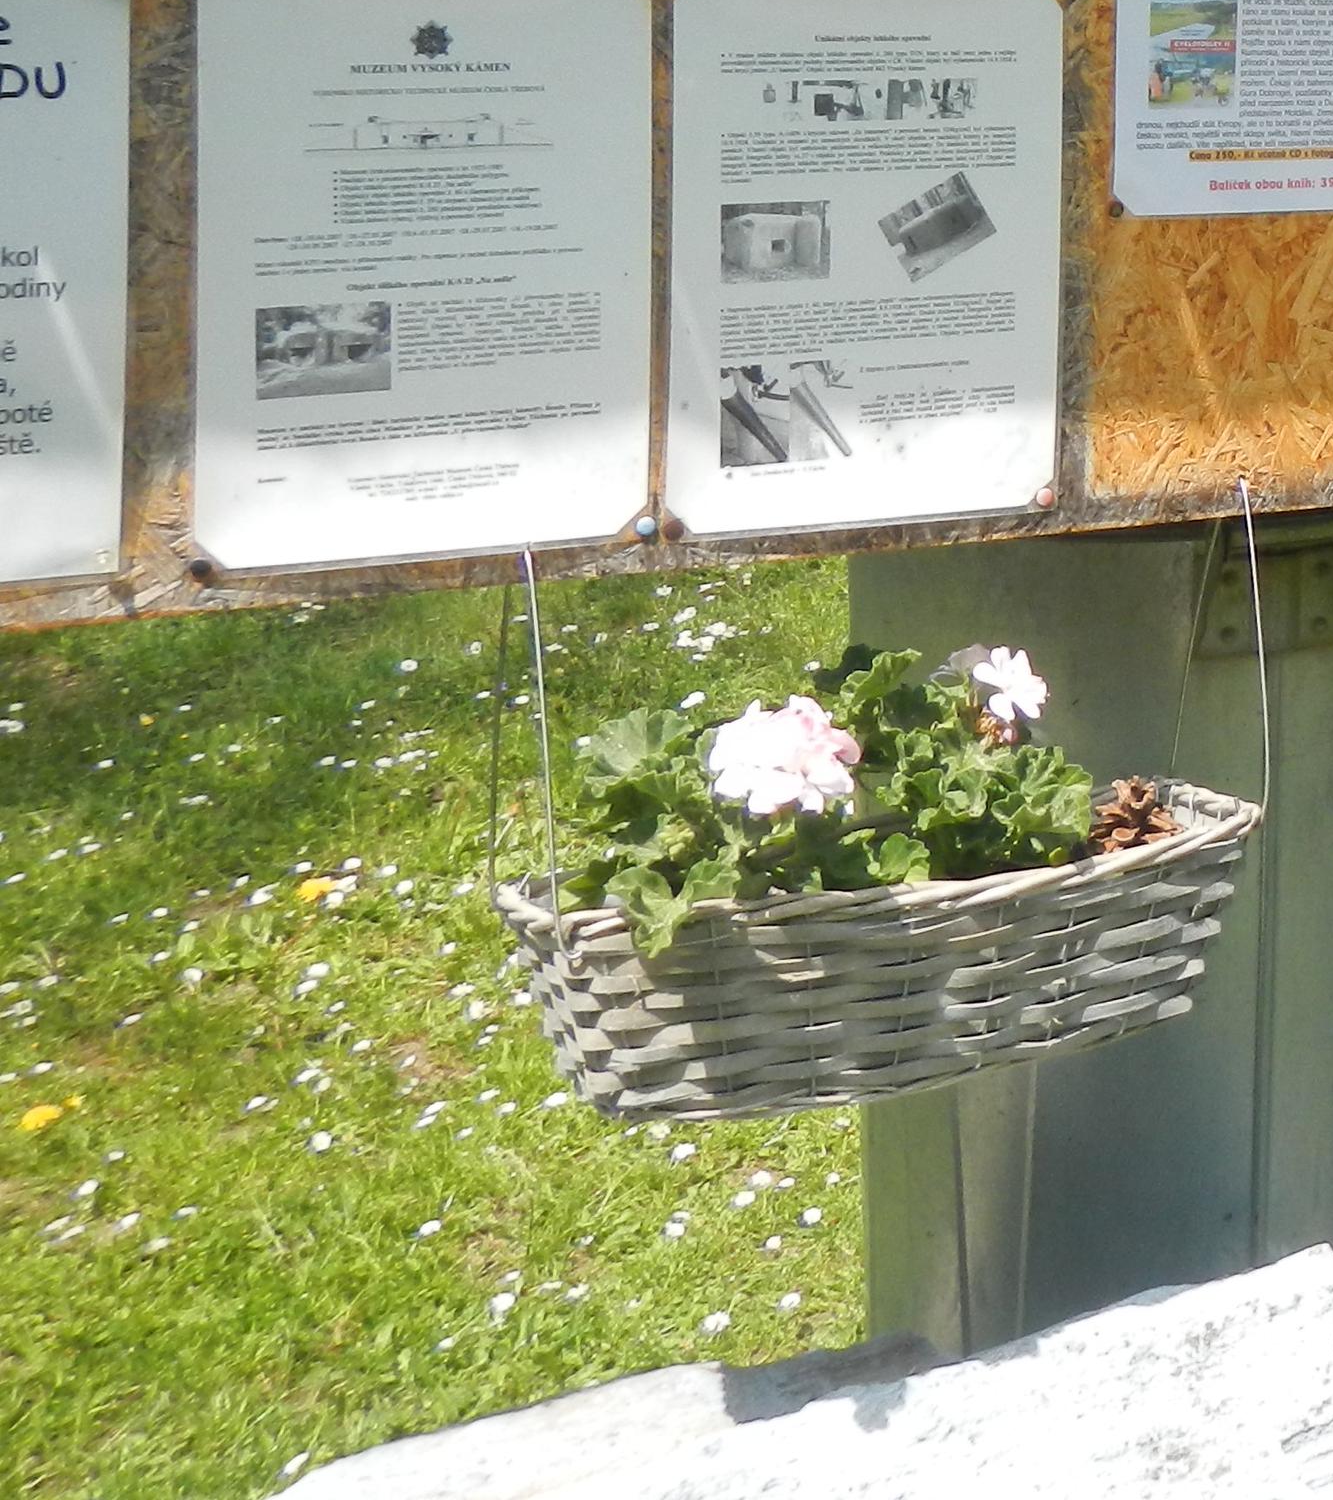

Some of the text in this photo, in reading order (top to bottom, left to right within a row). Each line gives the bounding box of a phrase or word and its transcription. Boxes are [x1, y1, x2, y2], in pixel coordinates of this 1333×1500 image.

[350, 62, 511, 74] MUZEUM VYSOKÝ KÁMEN
[1255, 179, 1283, 189] obou
[1287, 178, 1315, 189] knih:
